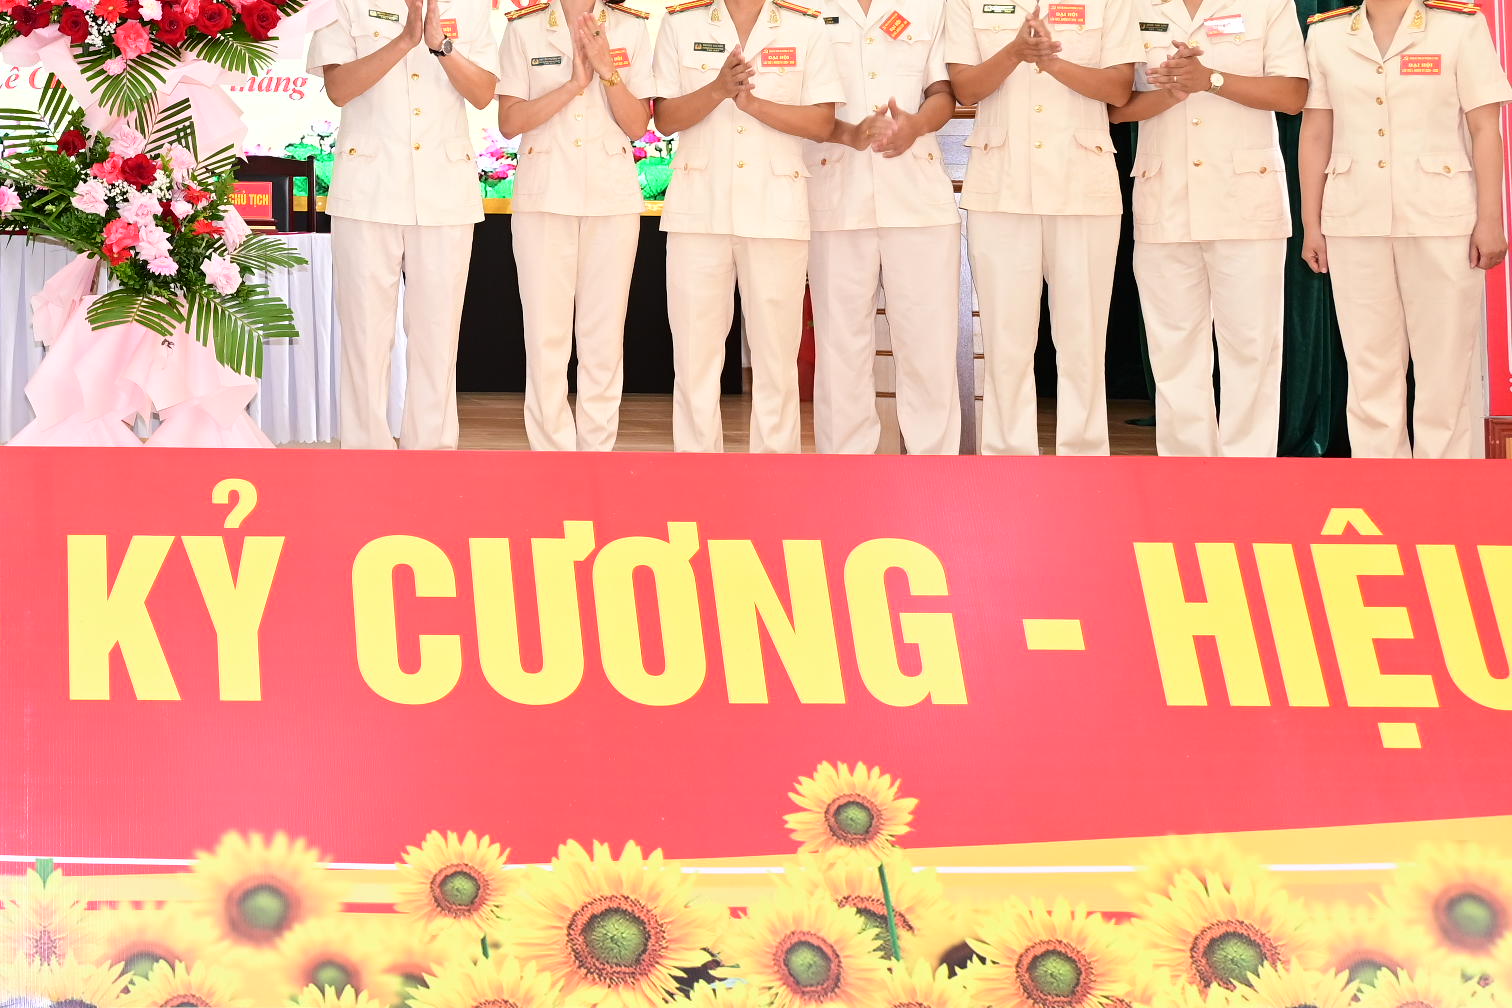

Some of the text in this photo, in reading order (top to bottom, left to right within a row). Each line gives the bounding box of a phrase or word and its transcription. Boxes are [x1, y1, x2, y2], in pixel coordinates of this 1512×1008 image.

[231, 69, 308, 100] áng
[249, 194, 268, 207] TỊCH
[67, 478, 286, 701] KỶ
[351, 520, 969, 708] CƯƠNG
[1133, 507, 1512, 749] HIỆU
